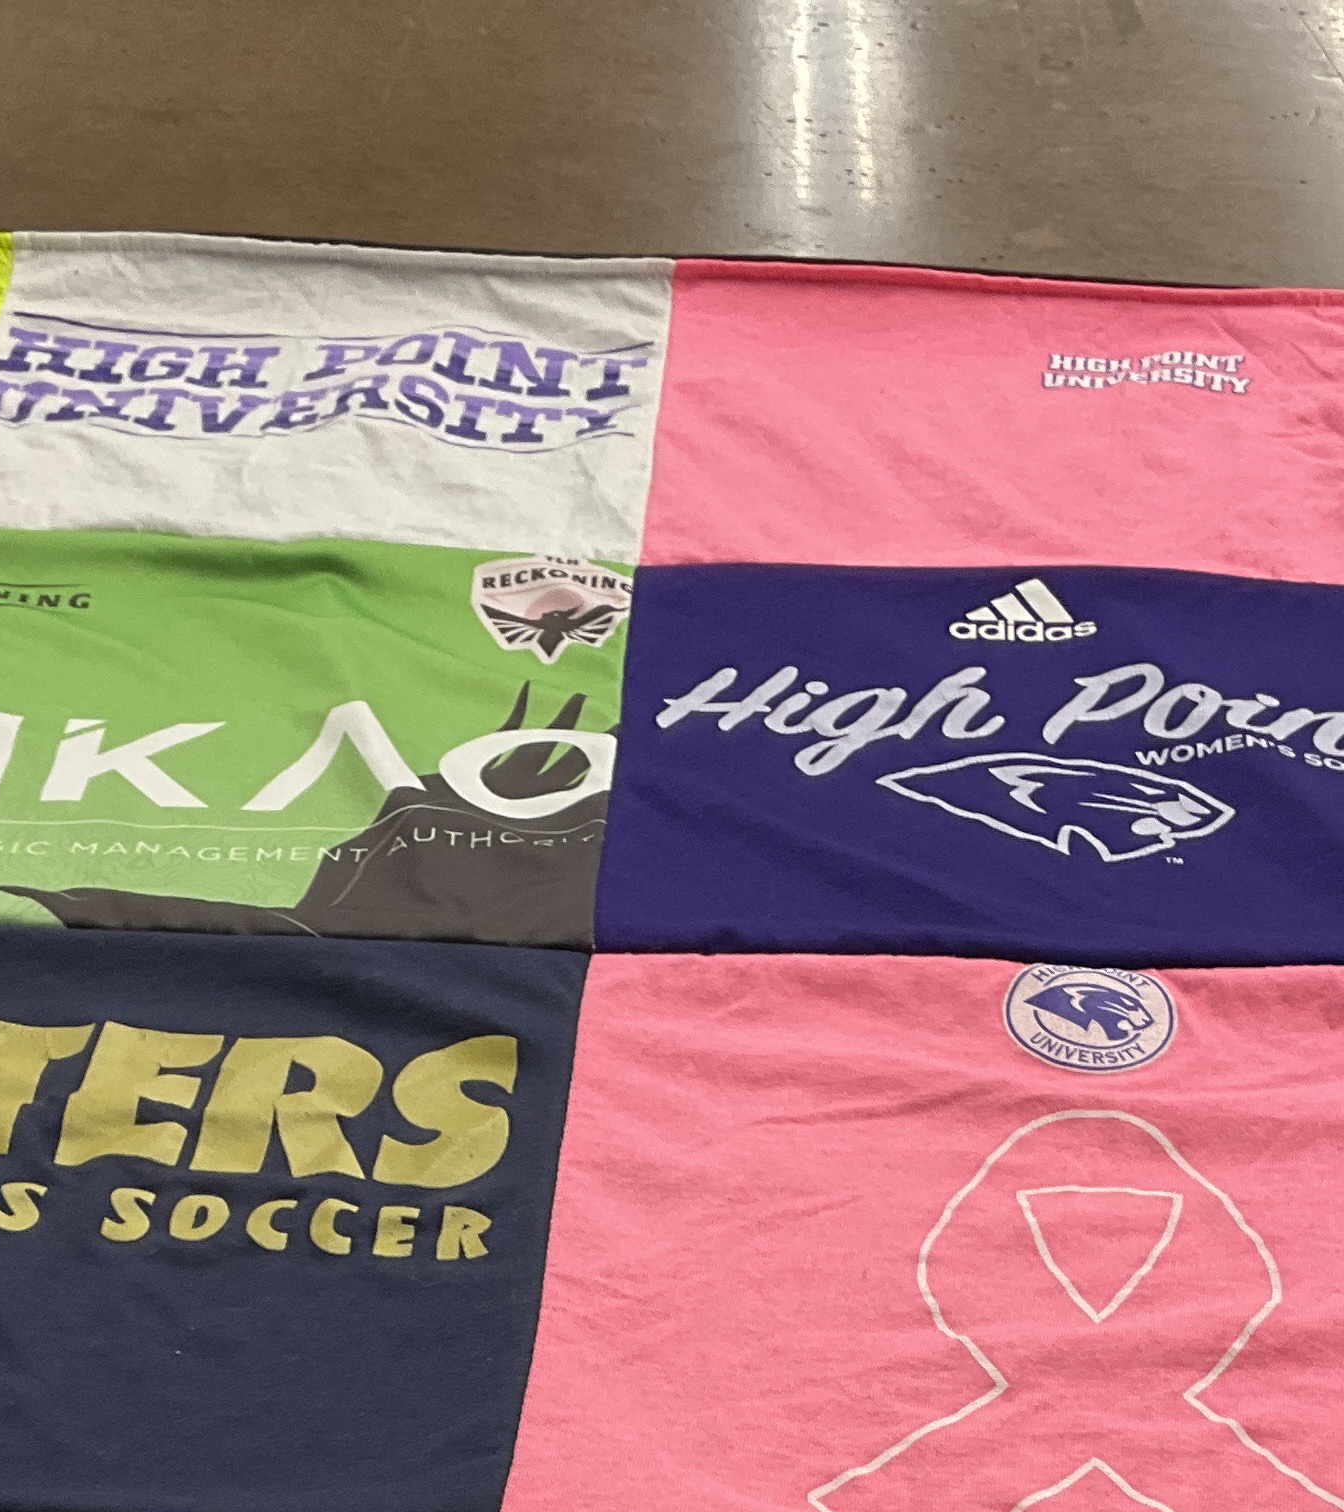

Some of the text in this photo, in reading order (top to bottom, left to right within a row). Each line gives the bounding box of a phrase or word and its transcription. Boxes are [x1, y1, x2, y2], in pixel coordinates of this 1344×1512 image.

[302, 331, 648, 401] POINT
[1048, 350, 1245, 374] HIGH POINT
[1042, 366, 1252, 395] UNIVERSITY
[949, 617, 1097, 642] adidas
[655, 665, 1006, 777] High
[68, 838, 370, 865] MANAGEMENT
[1029, 1031, 1147, 1065] UNIVERSITY
[98, 1187, 495, 1261] SOCCER
